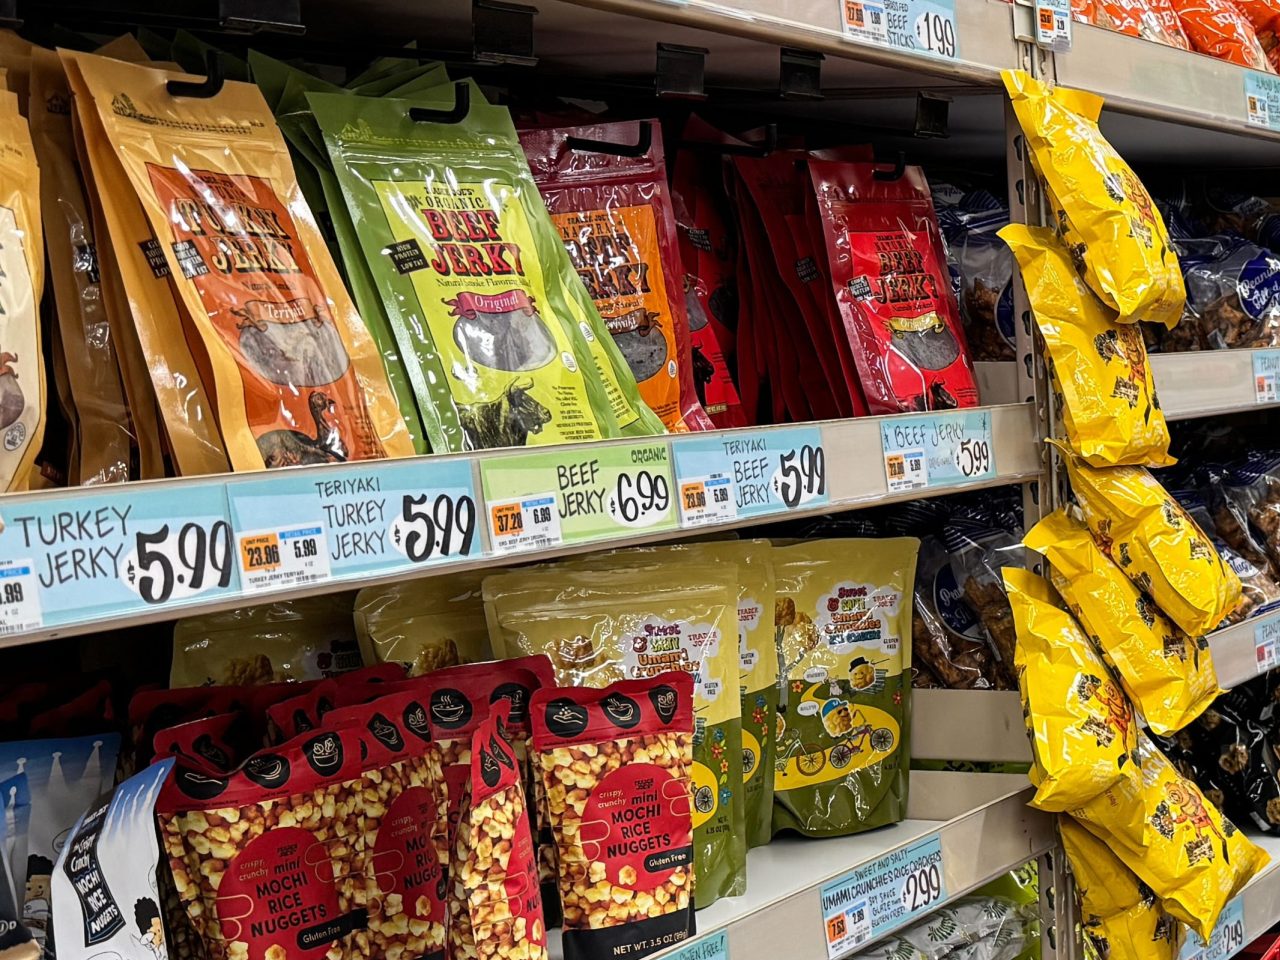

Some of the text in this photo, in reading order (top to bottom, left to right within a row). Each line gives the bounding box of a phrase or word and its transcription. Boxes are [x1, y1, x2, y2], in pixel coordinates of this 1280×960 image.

[887, 13, 908, 29] BEEF
[887, 32, 914, 49] STICKS
[427, 196, 484, 209] ORGANIC
[421, 209, 501, 242] BEEF
[209, 236, 302, 274] JERKY
[430, 243, 525, 277] JERKY
[876, 274, 941, 302] JERKY
[474, 294, 519, 311] Original
[1261, 357, 1279, 370] PEANUT
[723, 438, 767, 456] TERIYAKI
[894, 421, 965, 448] BEEF JERKY
[631, 448, 667, 463] ORGANIC
[557, 460, 600, 491] BEEF
[734, 456, 769, 483] BEEF
[315, 476, 381, 498] TERIYAKI
[736, 482, 770, 509] JERKY
[323, 499, 386, 529] TURKEY
[558, 488, 606, 519] JERKY
[14, 505, 132, 547] TURKEY
[394, 493, 476, 563] $5.99
[331, 528, 386, 561] JERKY
[39, 543, 124, 588] JERKY
[127, 520, 233, 604] $5.99
[1262, 620, 1280, 635] PEANUT
[637, 650, 689, 667] Umami
[632, 790, 657, 805] mini
[611, 805, 661, 825] MOCHI
[621, 822, 651, 837] RICE
[607, 834, 671, 857] NUGGETS
[649, 853, 686, 867] Gluten Free
[855, 848, 908, 881] SWEET AND SALTY
[255, 871, 308, 899] MOCHI
[823, 850, 941, 911] UMAMI CRUNCHIES RICE CRACKERS
[268, 892, 303, 915] RICE
[251, 903, 328, 938] NUGGETS
[303, 925, 341, 943] Gluten Free
